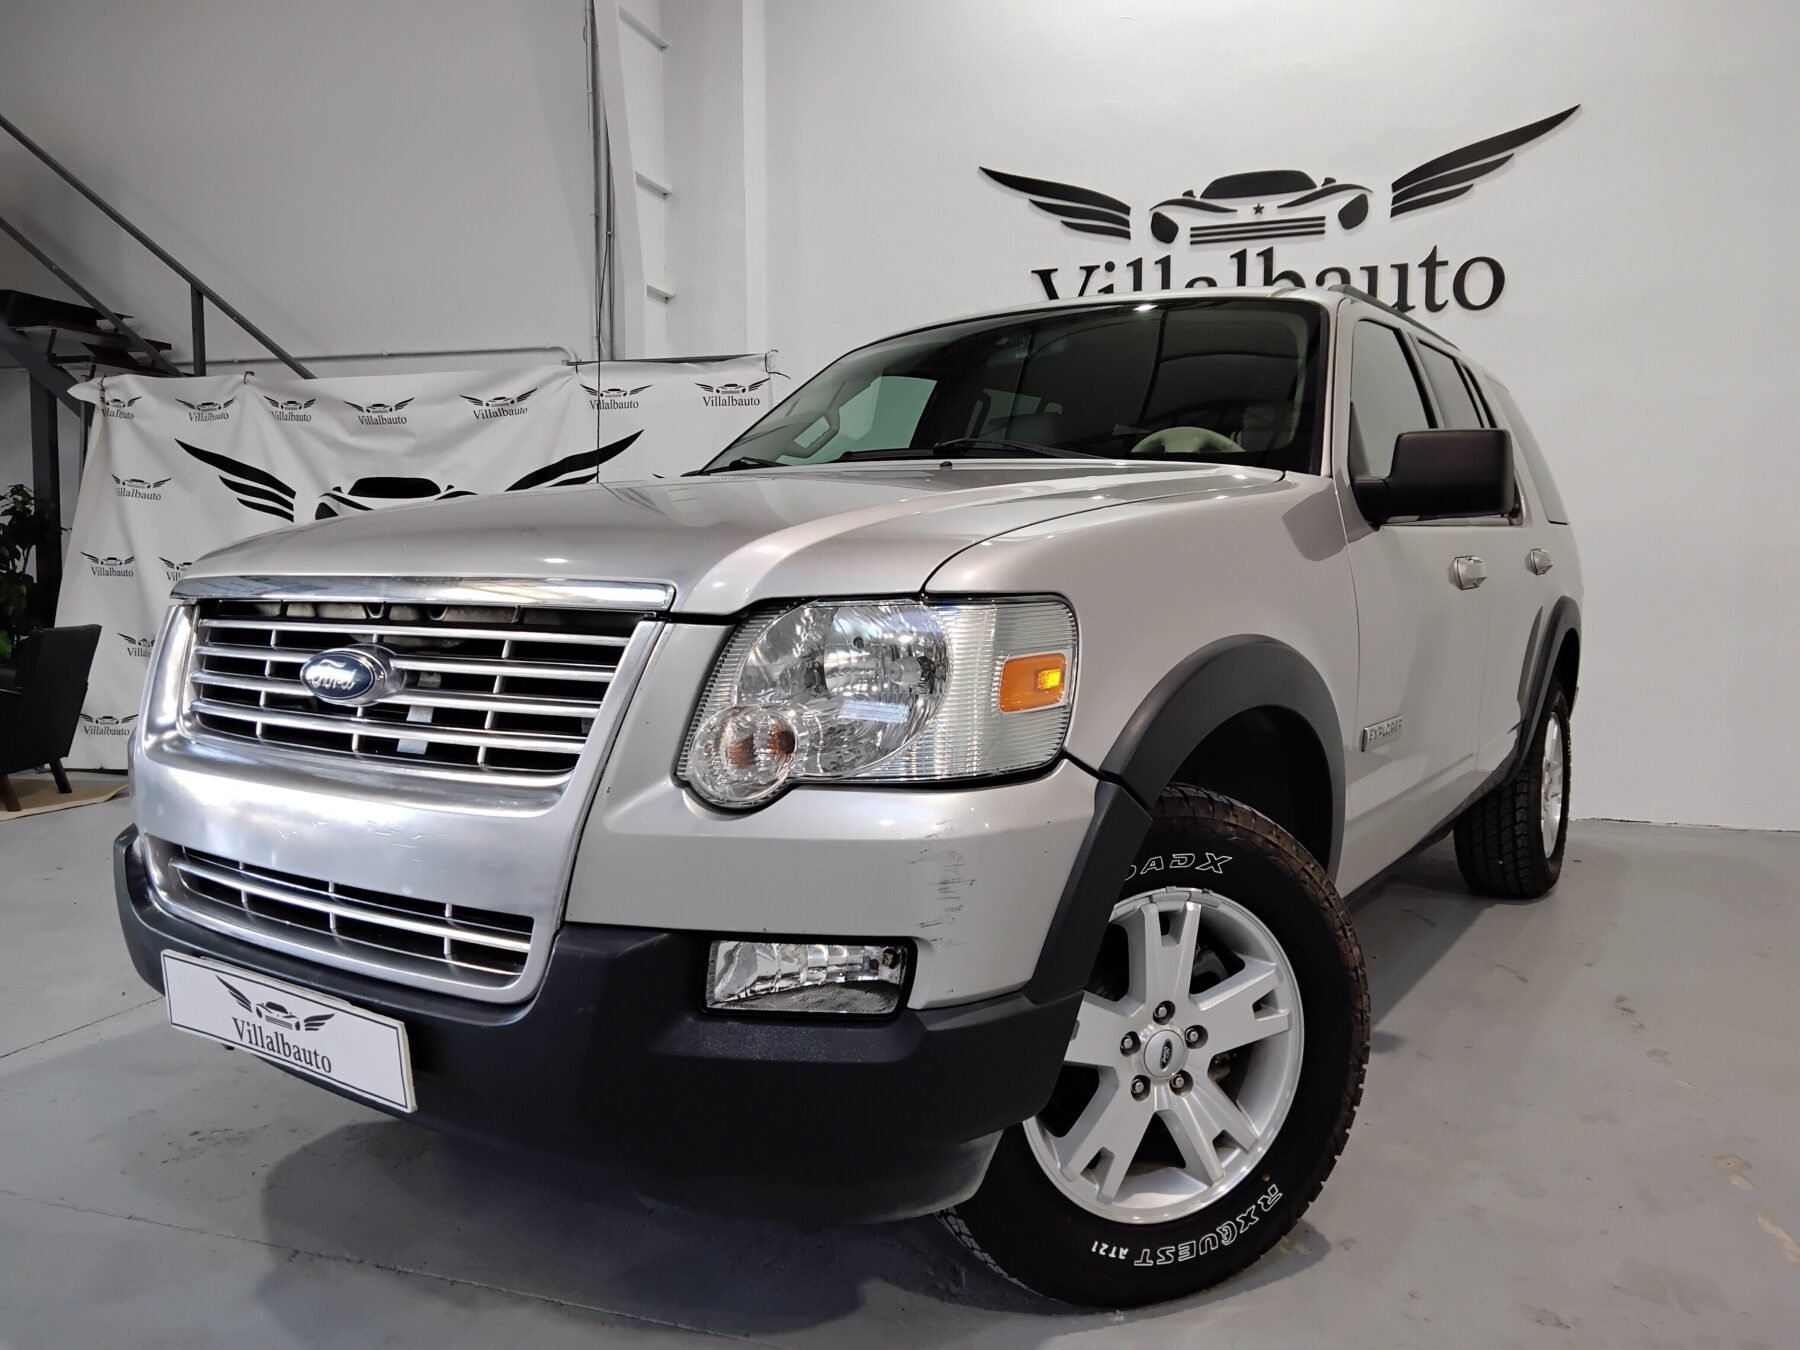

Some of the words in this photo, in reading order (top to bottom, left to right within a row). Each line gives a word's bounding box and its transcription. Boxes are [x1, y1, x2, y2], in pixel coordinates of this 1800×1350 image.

[1031, 245, 1505, 313] Villlbuto
[702, 395, 760, 407] Villalbauto
[188, 411, 229, 422] Villalbauto
[271, 411, 312, 422] Villalbauto
[473, 407, 528, 420] Villalbauto
[358, 415, 407, 425] Villalbauto
[91, 566, 134, 577] Villalbauto
[83, 725, 130, 736] Villalbauto
[231, 1016, 332, 1073] Villalbauto
[1133, 1183, 1283, 1267] RXQUEST
[1091, 1240, 1129, 1260] AT21
